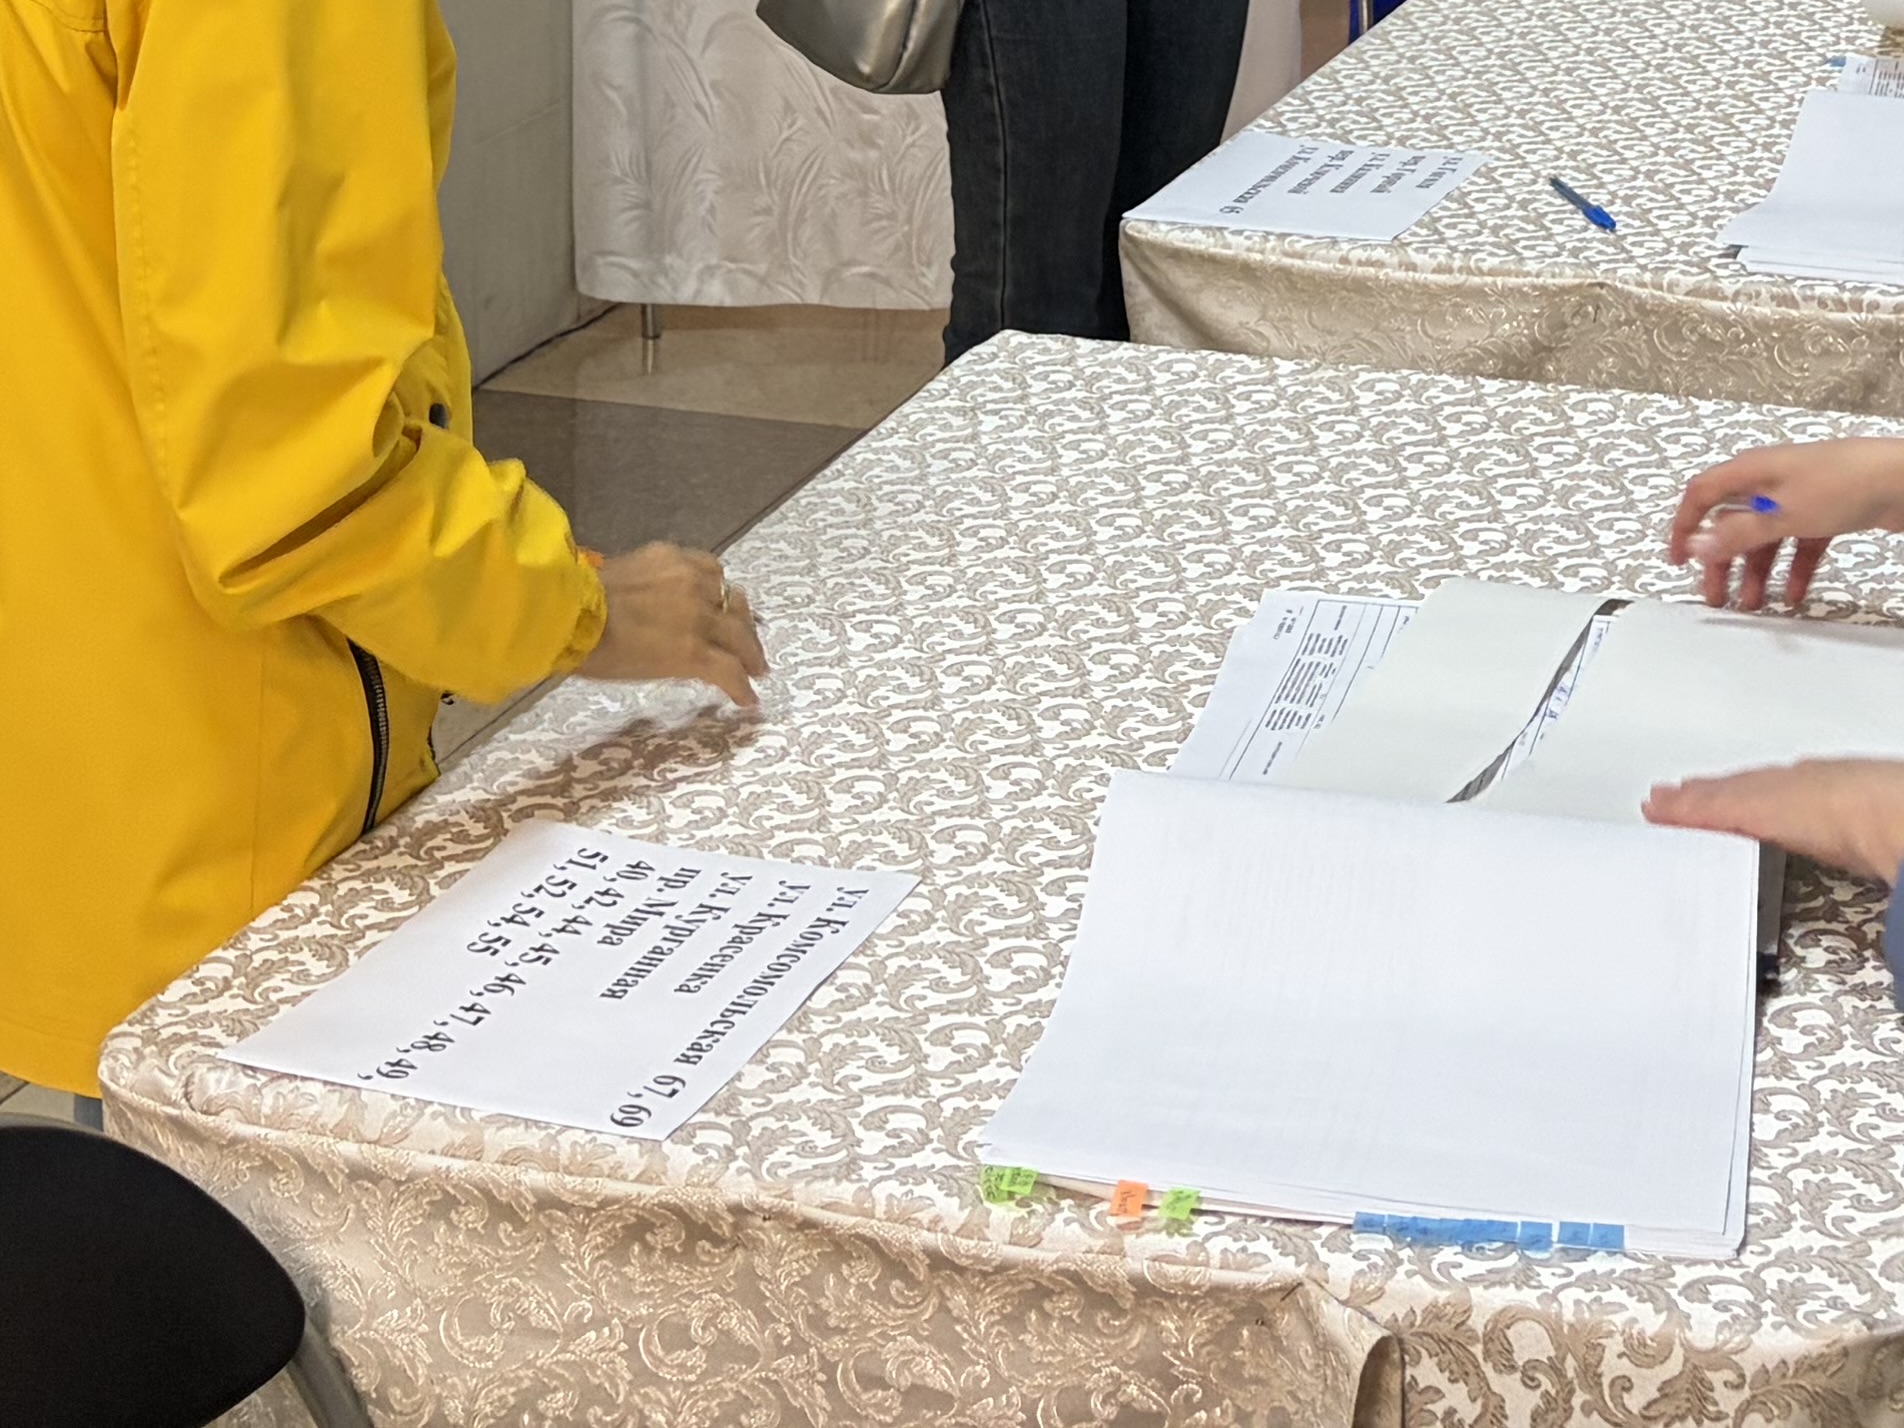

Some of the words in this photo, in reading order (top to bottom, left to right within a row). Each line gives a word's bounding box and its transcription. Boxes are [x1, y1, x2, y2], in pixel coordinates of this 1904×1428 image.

[554, 848, 608, 870] 51,
[603, 861, 655, 882] 40,
[657, 868, 701, 892] пр.
[521, 876, 577, 898] 52,
[709, 872, 752, 897] ул.
[768, 881, 810, 907] ул.
[572, 888, 624, 909] 42,
[826, 887, 869, 911] ул.
[488, 903, 544, 927] 54,
[539, 916, 592, 937] 44,
[597, 898, 677, 945] Мира
[467, 933, 511, 956] 55
[505, 944, 559, 966] 45,
[600, 903, 730, 999] Курганная
[674, 912, 789, 993] Красенка
[470, 974, 526, 996] 46,
[674, 917, 848, 1065] Комсомольская
[434, 1003, 490, 1026] 47,
[397, 1032, 454, 1053] 48,
[358, 1059, 417, 1080] 49,
[628, 1075, 686, 1098] 67,
[610, 1105, 651, 1127] 69
